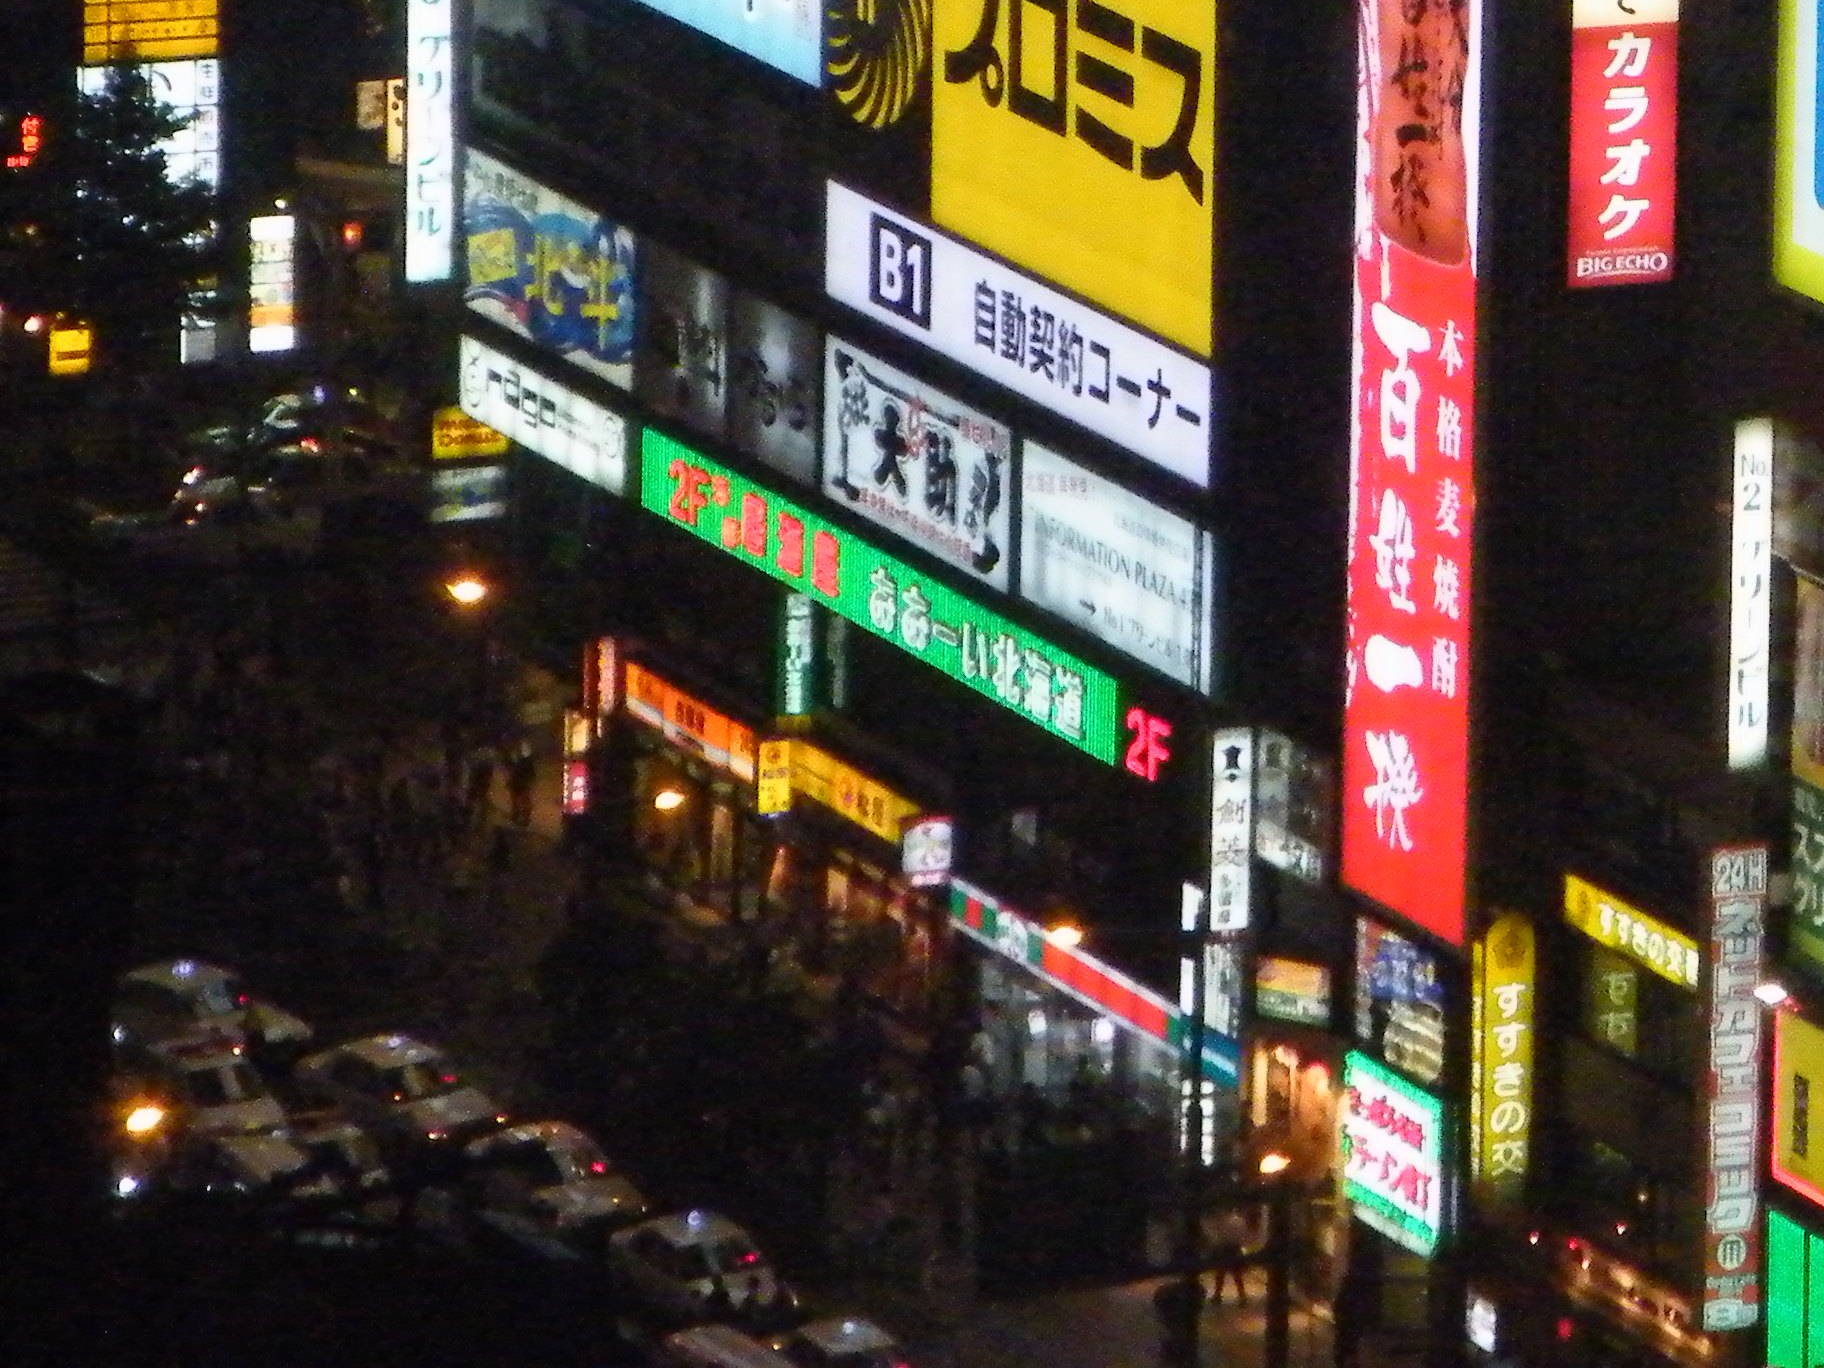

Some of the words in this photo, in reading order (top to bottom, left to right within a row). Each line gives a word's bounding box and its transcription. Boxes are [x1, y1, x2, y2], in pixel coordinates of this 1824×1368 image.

[1597, 30, 1652, 241] カラオケ
[878, 230, 924, 318] B1
[1576, 257, 1614, 278] BIG
[1615, 252, 1668, 272] ECHO
[973, 279, 1202, 430] 自動契約コーナー
[1431, 318, 1464, 700] 本格麦焼酎
[1124, 706, 1172, 782] 2F
[1713, 851, 1767, 896] 24H
